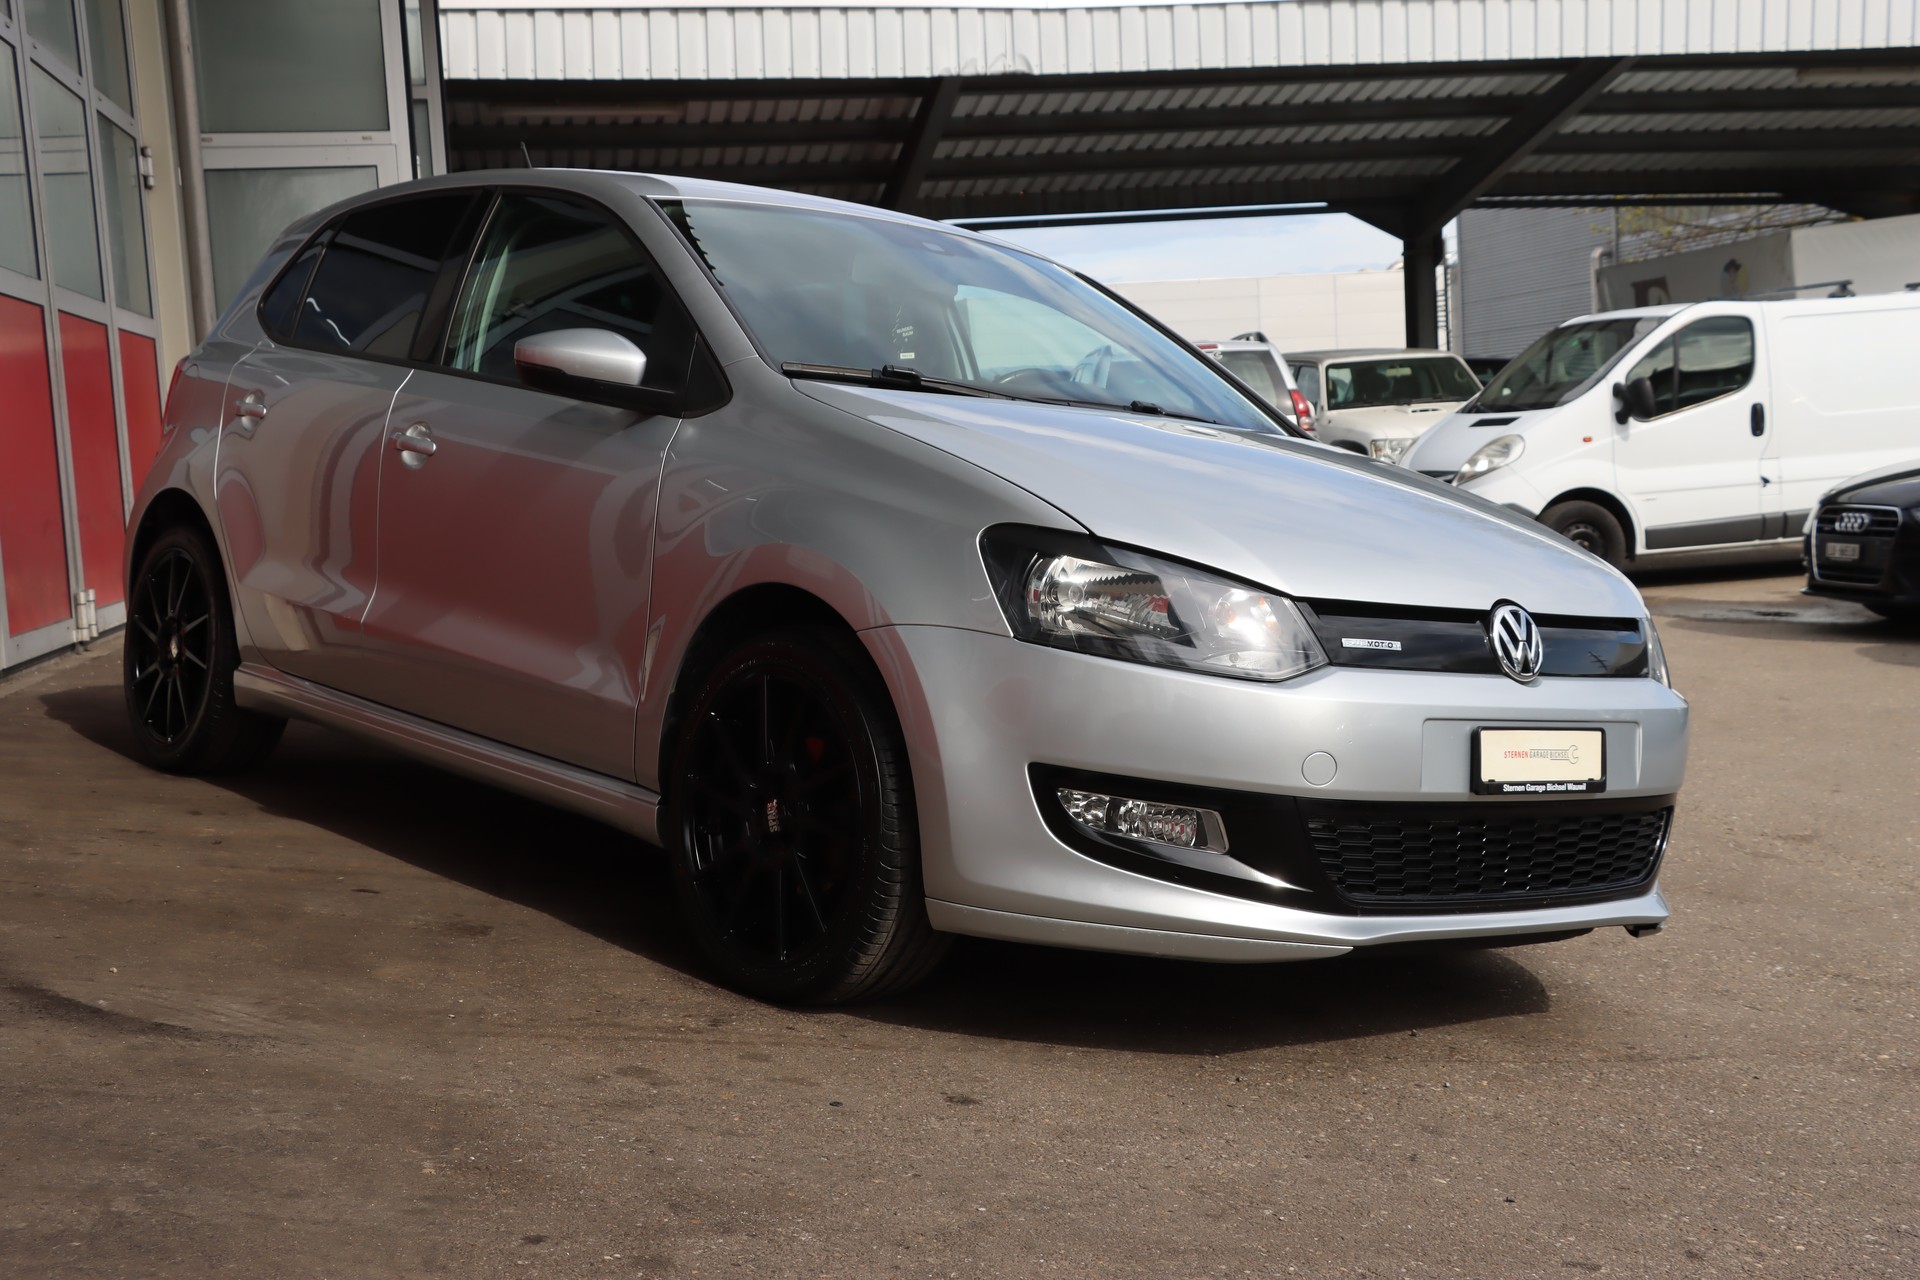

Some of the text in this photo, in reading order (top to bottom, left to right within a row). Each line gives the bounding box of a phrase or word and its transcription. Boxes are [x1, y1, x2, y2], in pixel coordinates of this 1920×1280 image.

[1504, 750, 1569, 758] STERNEN GARAGE BICHSEL
[1503, 783, 1525, 792] Sternen
[1526, 783, 1546, 793] Garage
[1546, 783, 1567, 791] Bichsel
